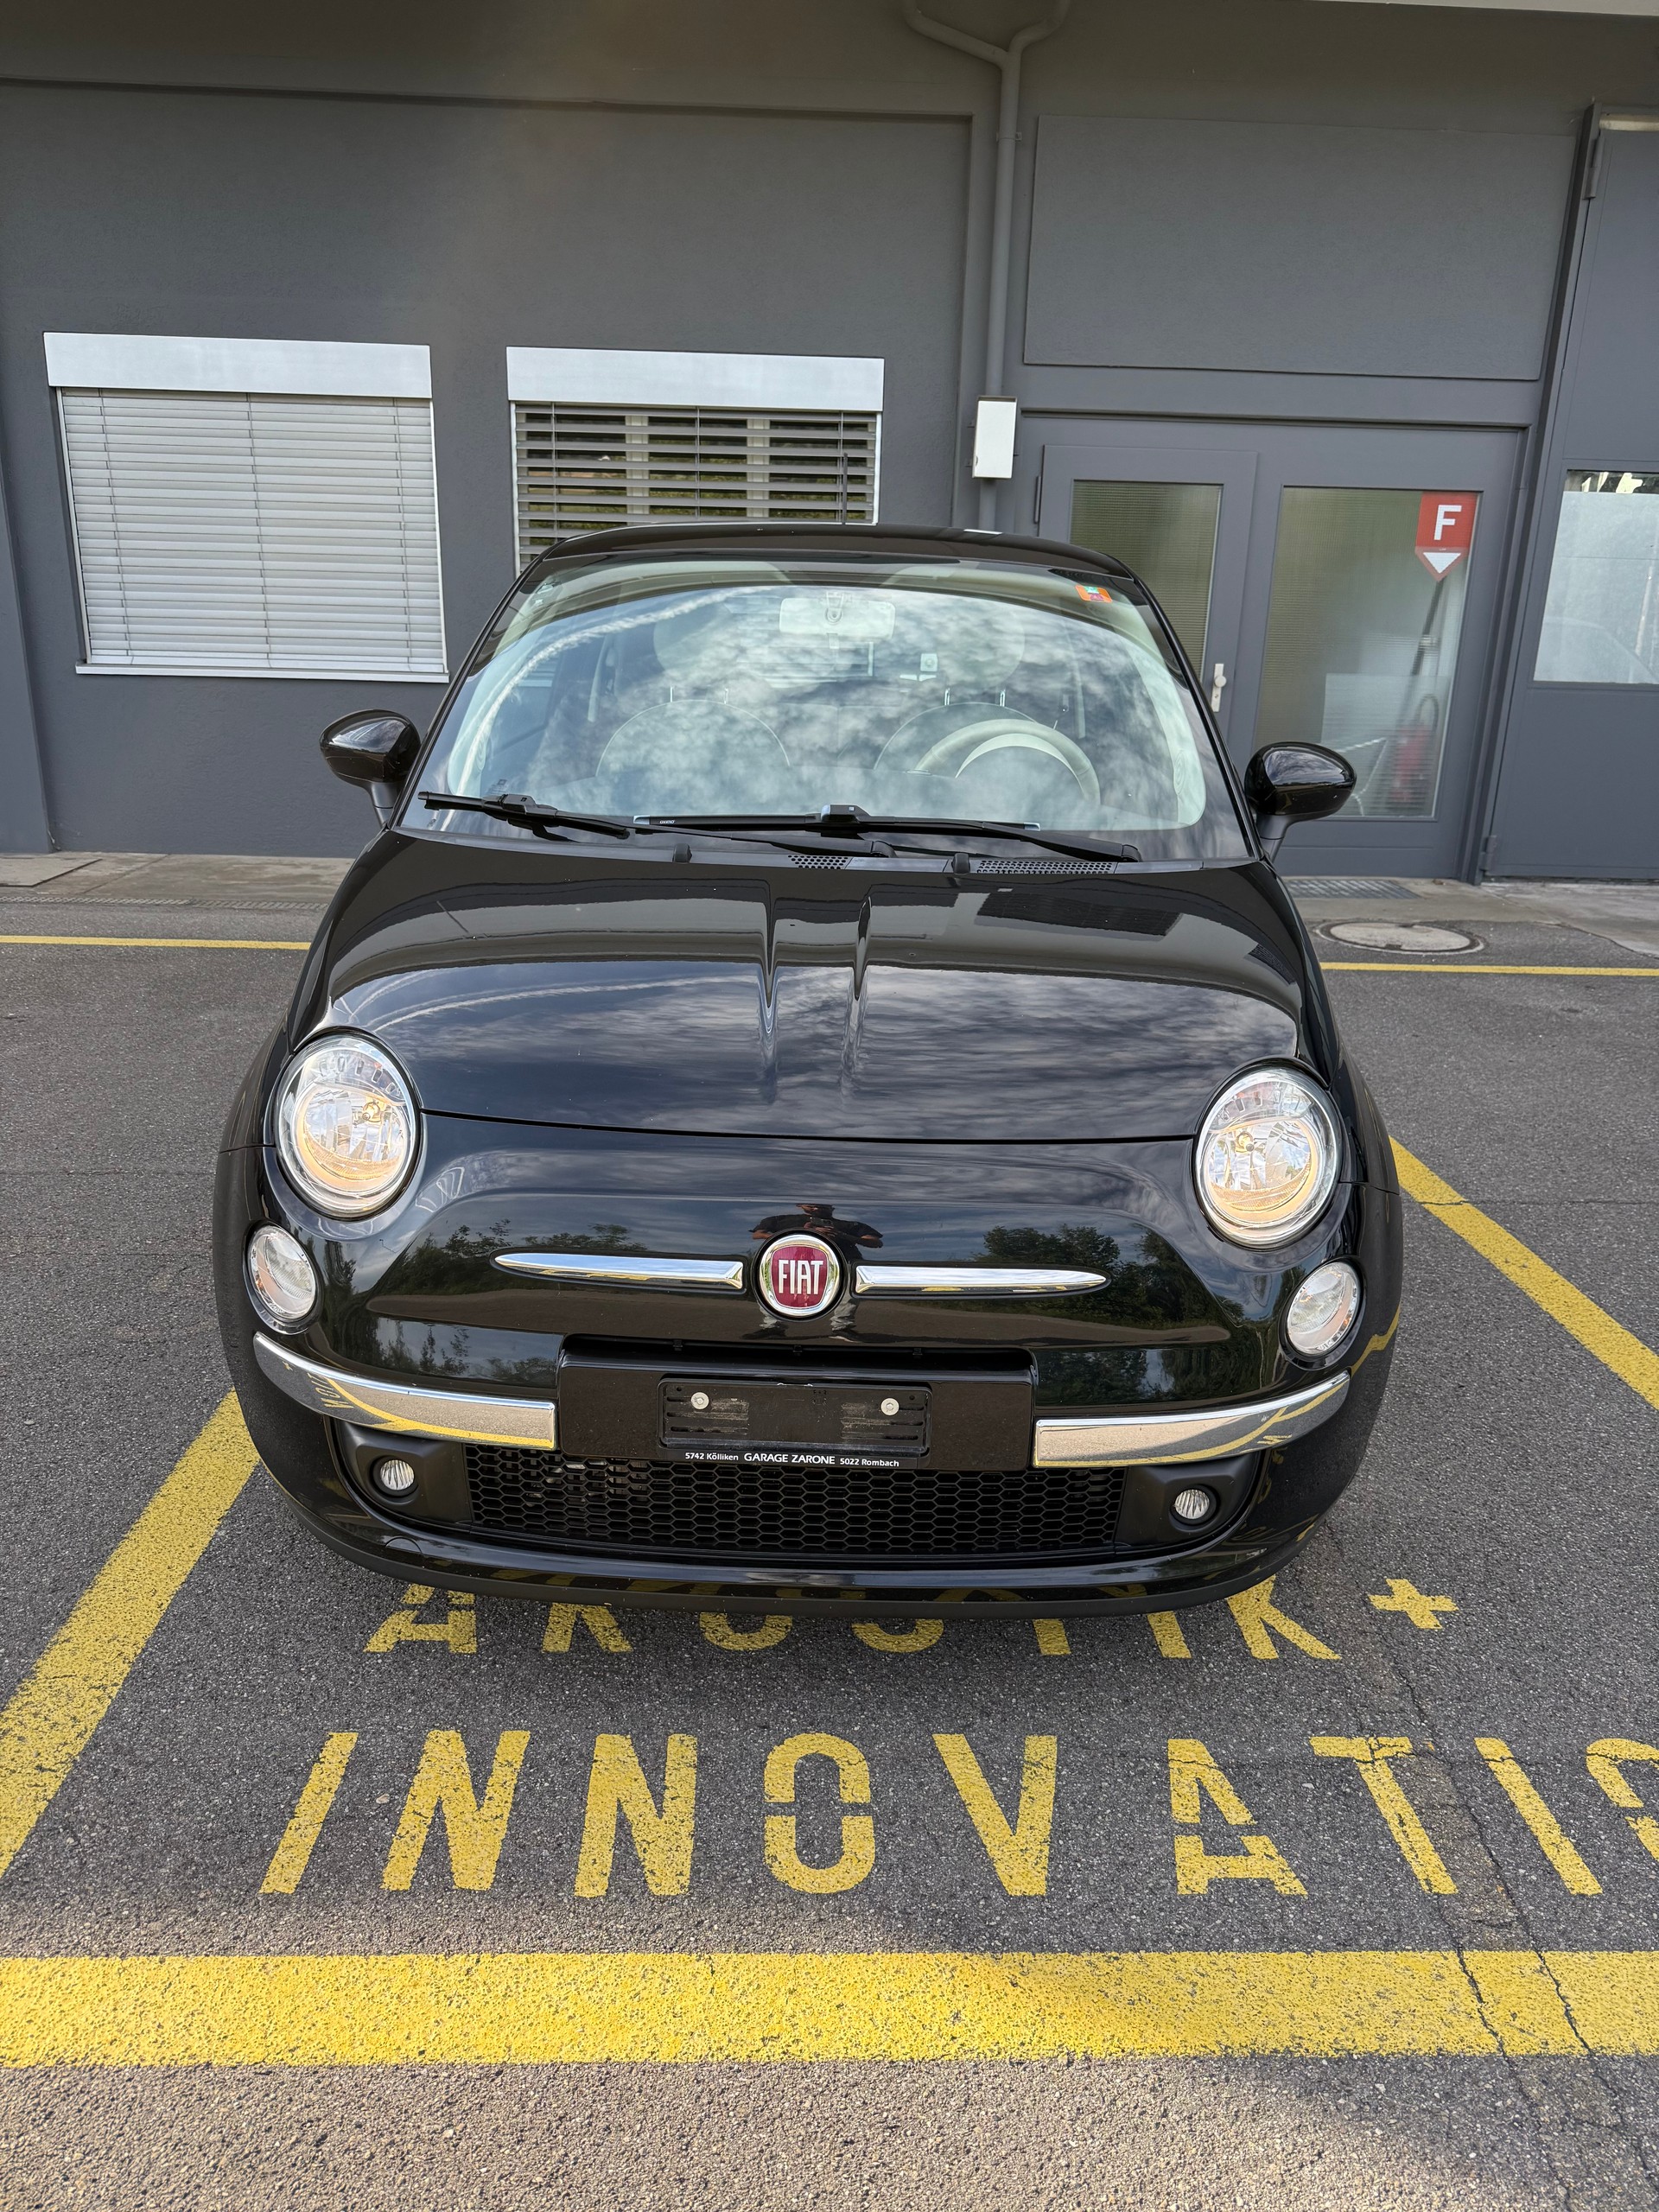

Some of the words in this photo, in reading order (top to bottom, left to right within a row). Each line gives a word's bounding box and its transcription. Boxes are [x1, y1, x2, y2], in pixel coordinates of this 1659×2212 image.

[1433, 504, 1462, 540] F
[779, 1259, 823, 1294] FIAT
[706, 1452, 739, 1461] Kölliken
[744, 1452, 788, 1463] GARAGE
[791, 1454, 836, 1465] ZARONE
[861, 1459, 899, 1467] Rombach
